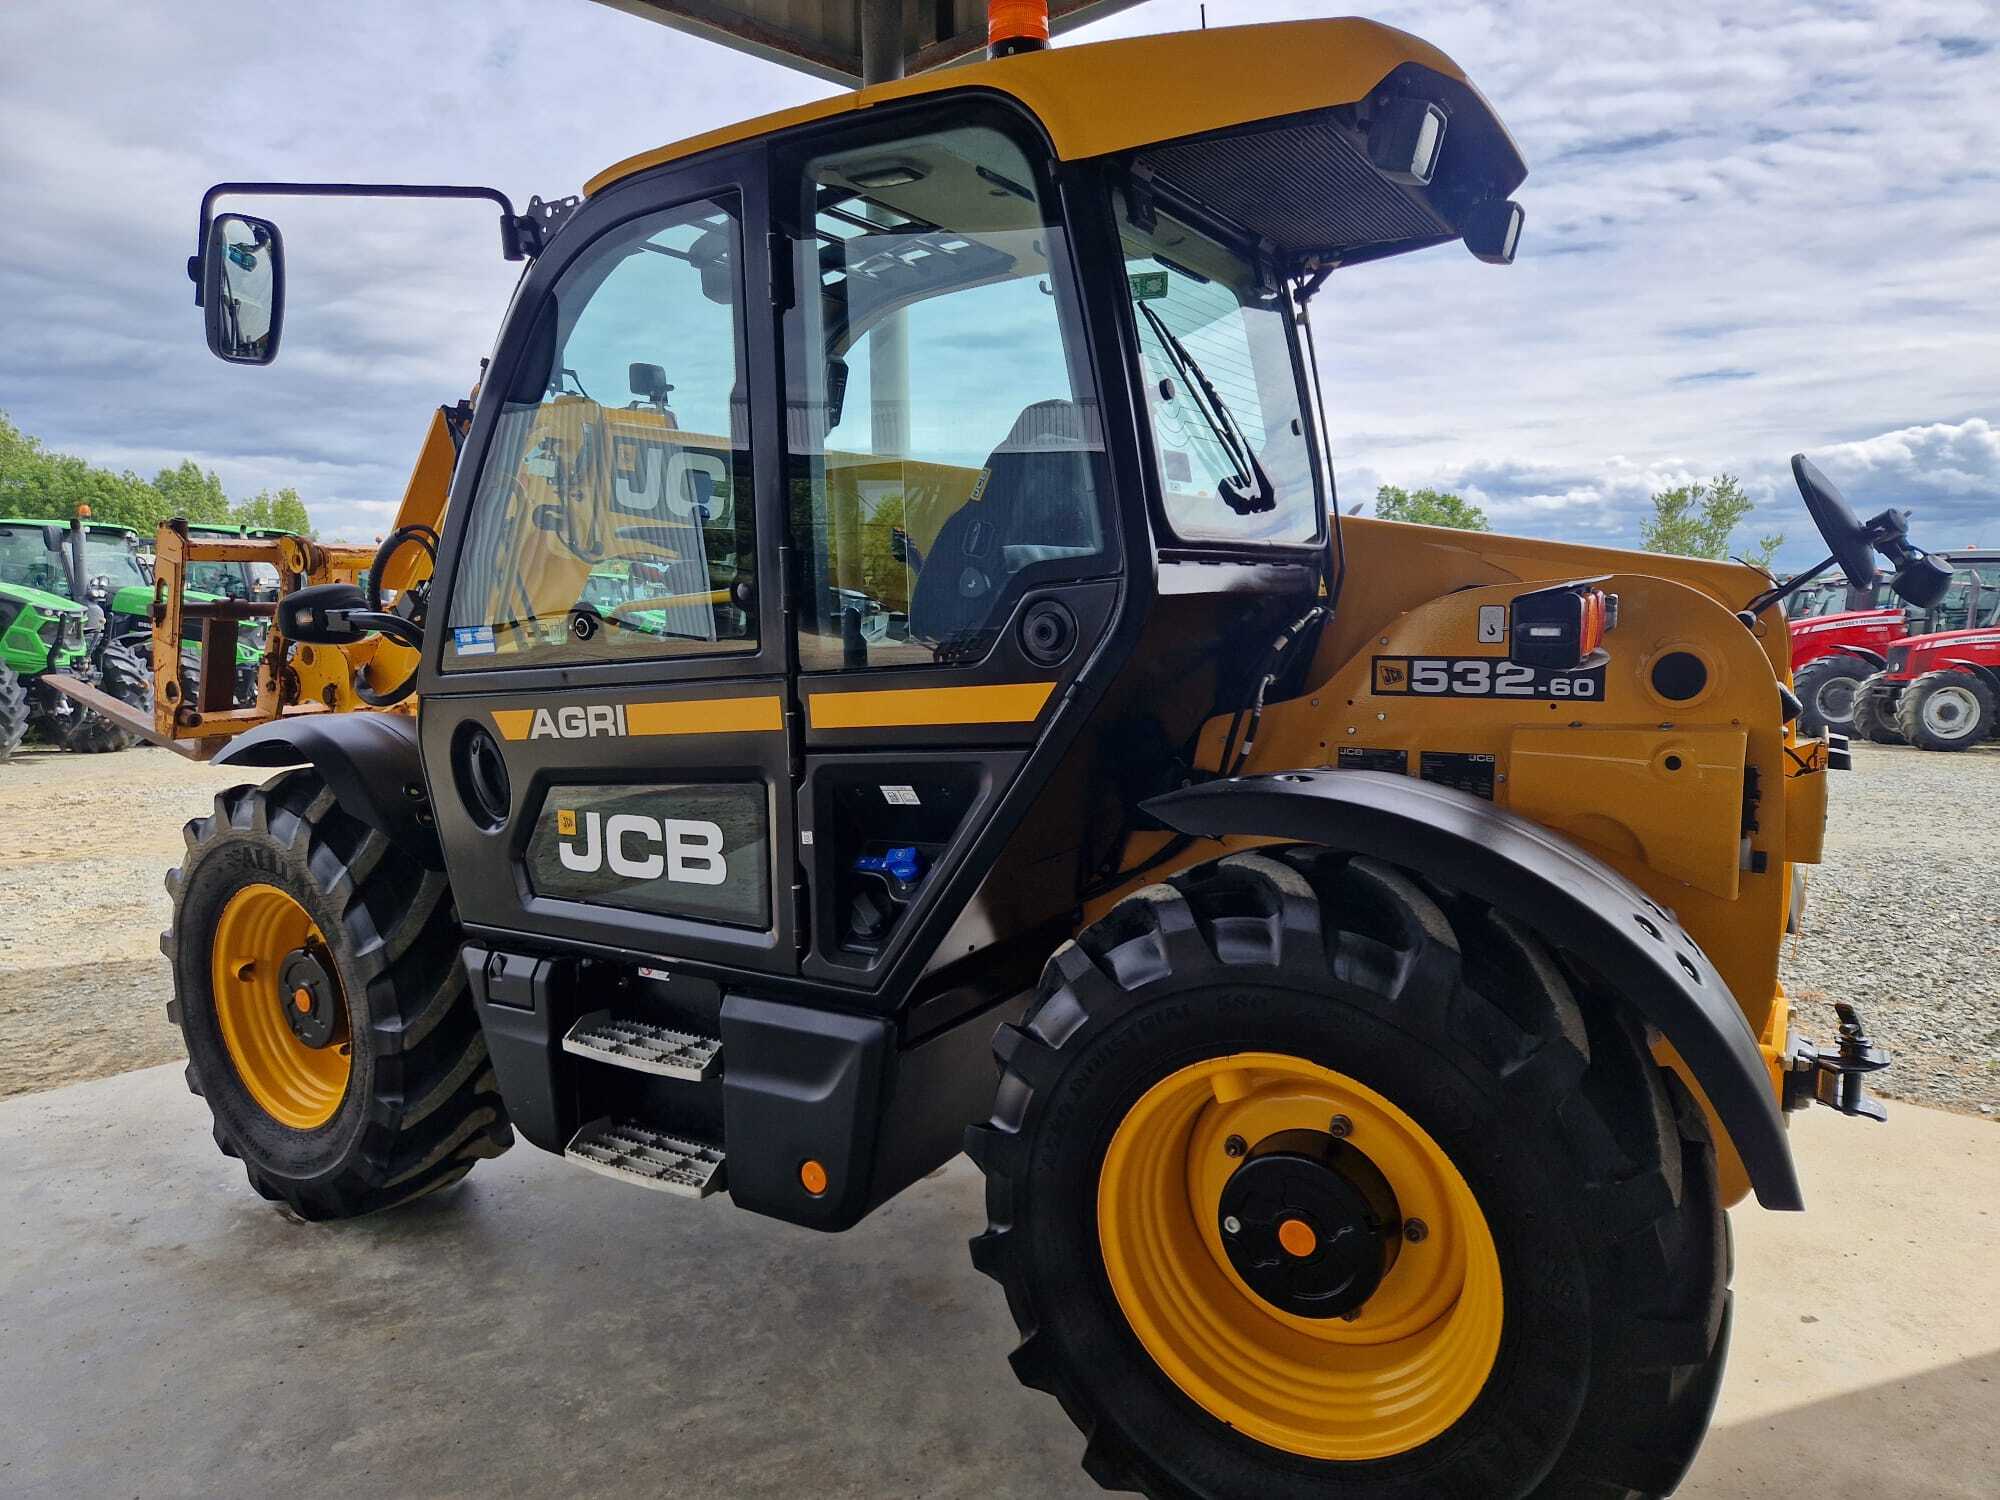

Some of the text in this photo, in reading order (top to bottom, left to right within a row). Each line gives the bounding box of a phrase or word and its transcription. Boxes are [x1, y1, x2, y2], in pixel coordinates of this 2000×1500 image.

[615, 448, 726, 520] JC
[1382, 660, 1595, 696] JCB 532-60
[529, 704, 627, 739] AGRI
[1339, 747, 1363, 756] JCB
[1468, 754, 1494, 762] JCB
[559, 812, 727, 886] JCB
